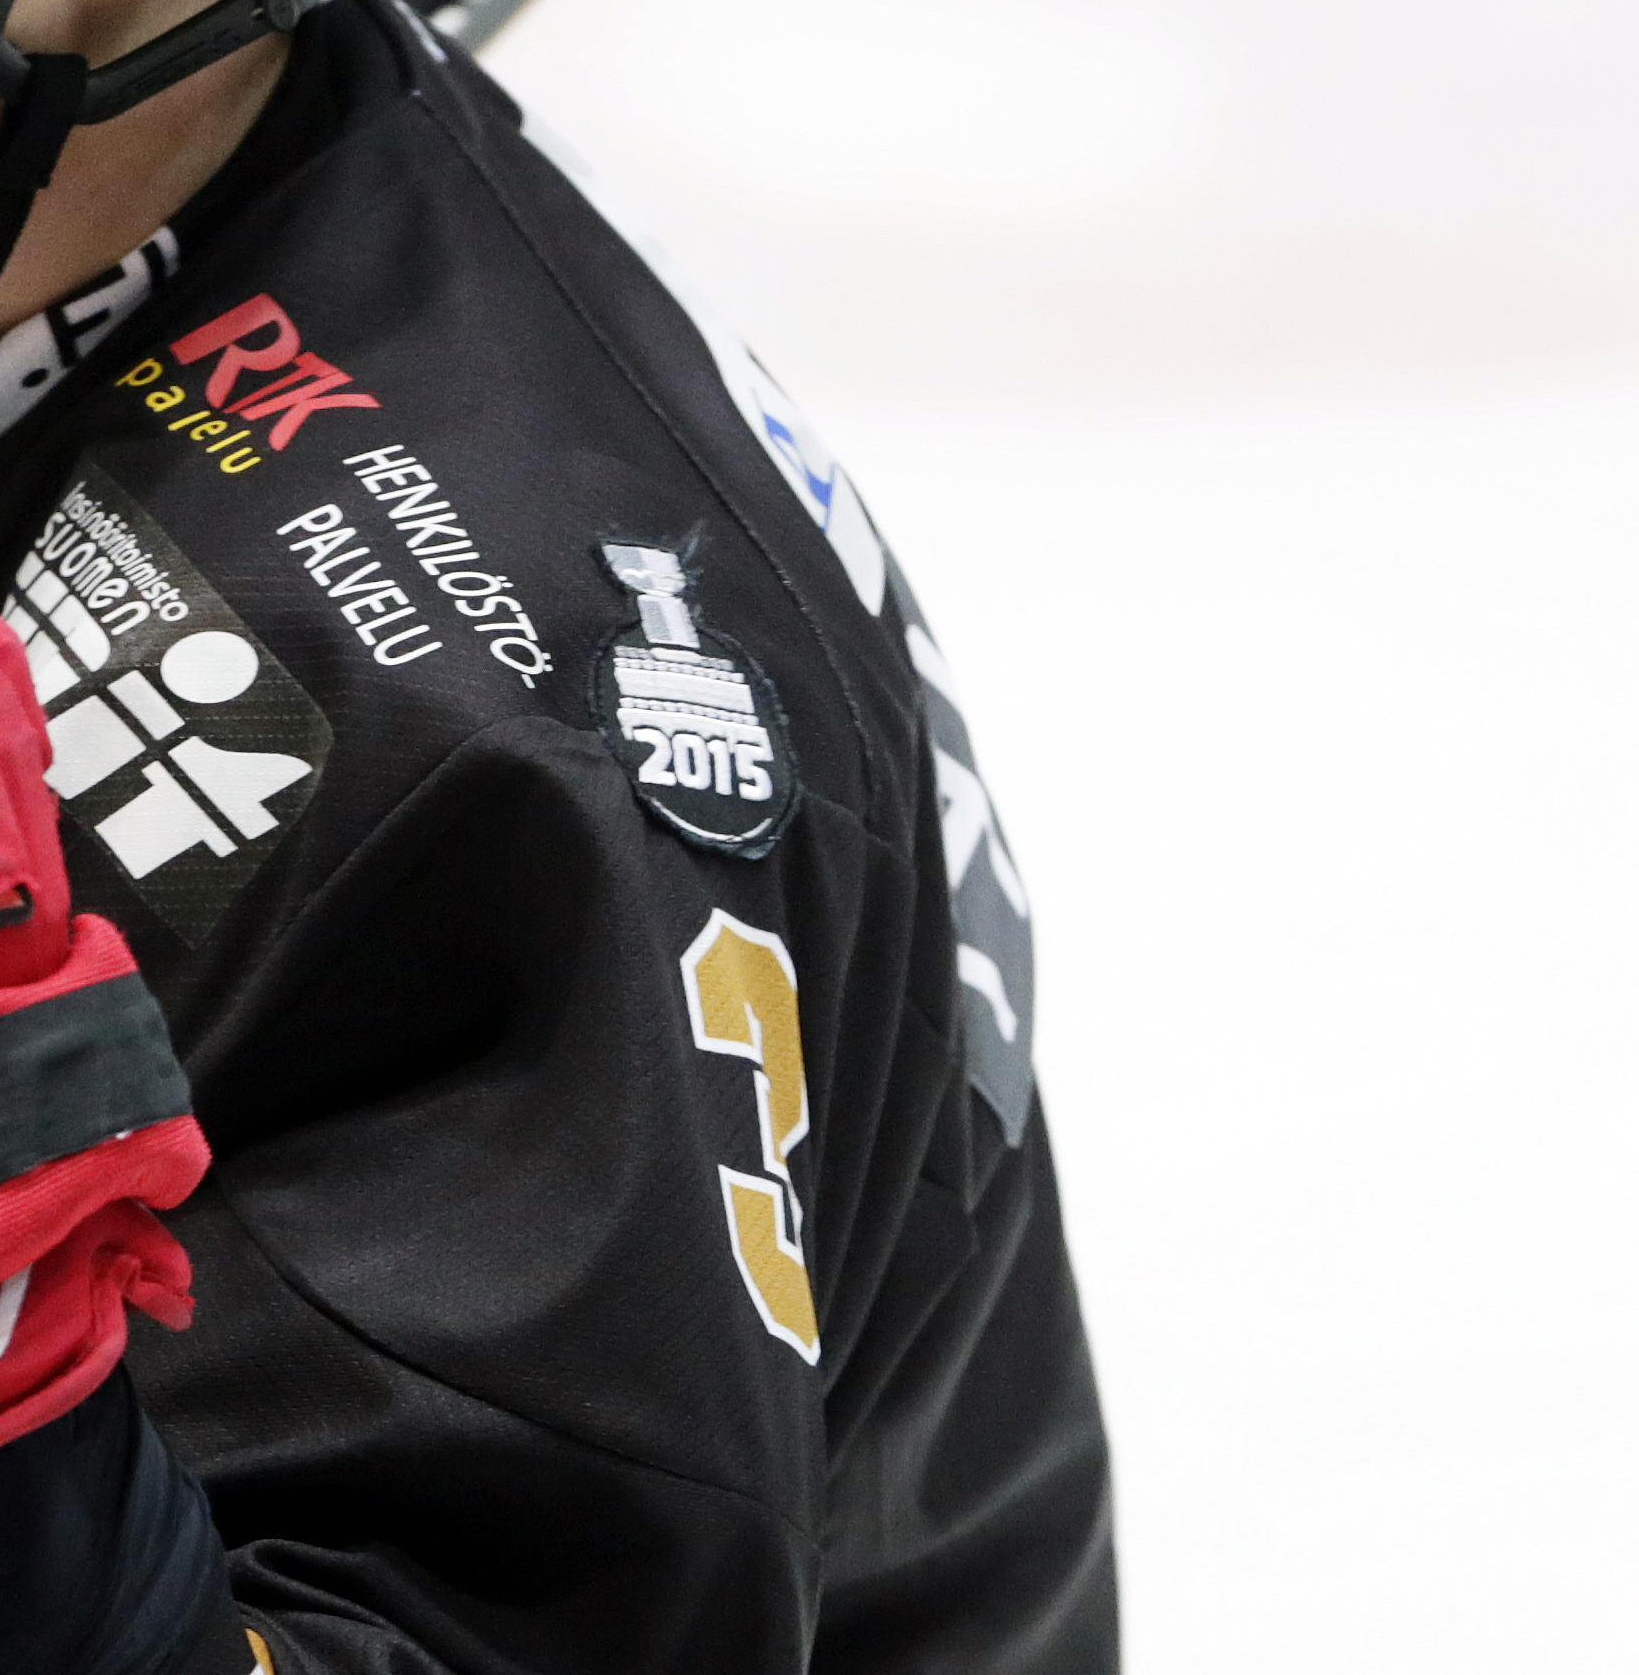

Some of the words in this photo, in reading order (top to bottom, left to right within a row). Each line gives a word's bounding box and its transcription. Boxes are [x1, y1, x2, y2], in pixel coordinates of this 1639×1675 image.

[169, 292, 383, 451] RTK
[275, 503, 444, 667] PALVELU
[342, 443, 554, 690] HENKILÖSTÖ-
[632, 726, 773, 803] 2015
